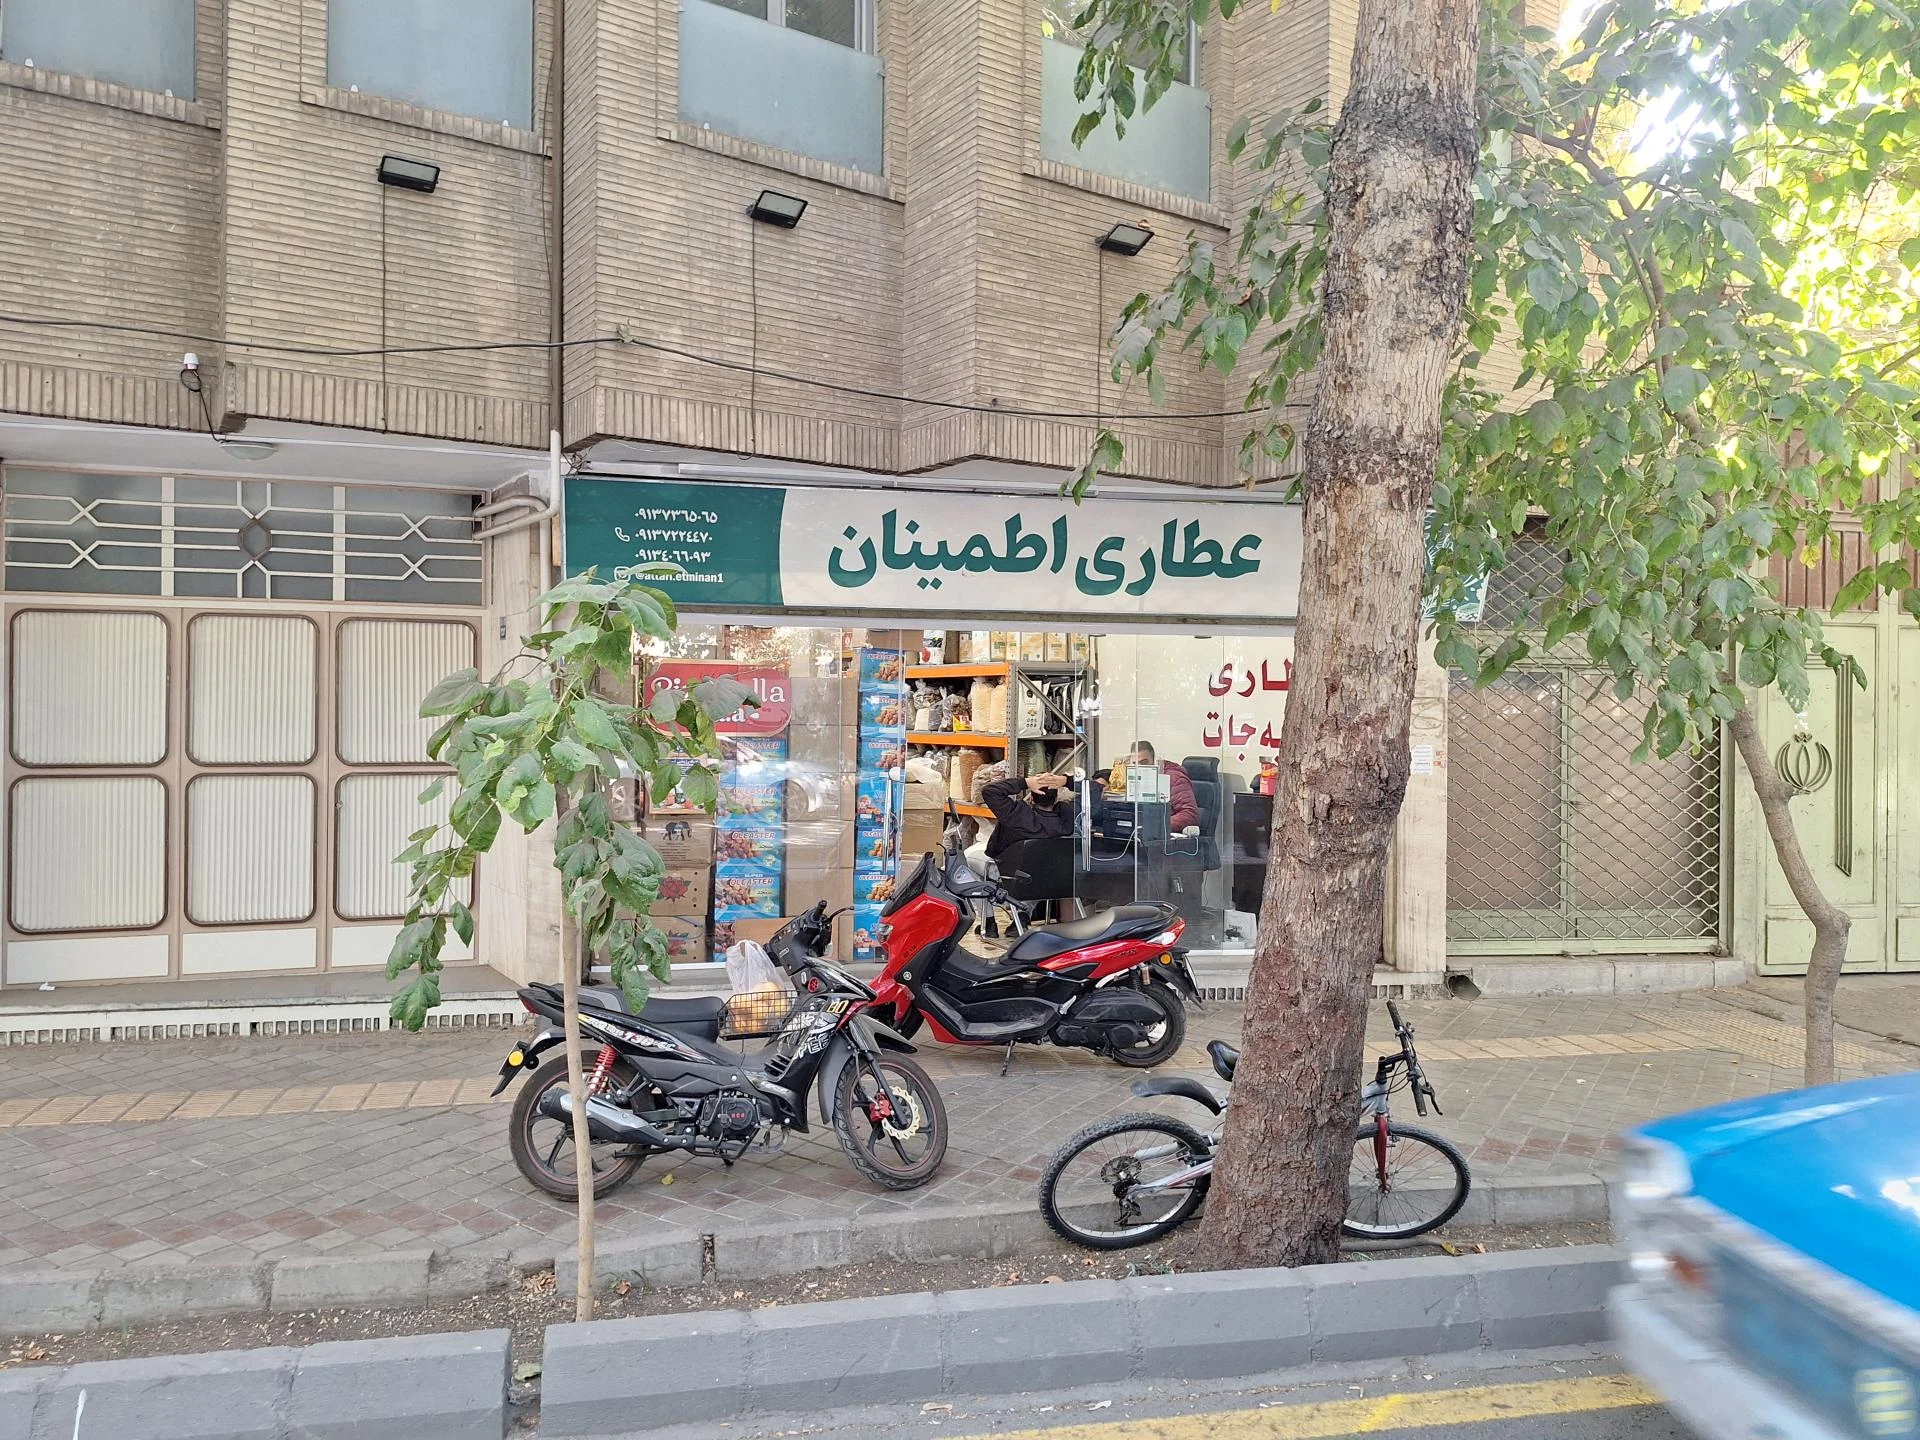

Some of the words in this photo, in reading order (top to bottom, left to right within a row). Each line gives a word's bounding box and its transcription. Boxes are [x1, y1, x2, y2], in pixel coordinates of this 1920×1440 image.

[828, 508, 1068, 591] اطمینان
[1075, 518, 1263, 596] عطاری
[1208, 658, 1293, 698] اری
